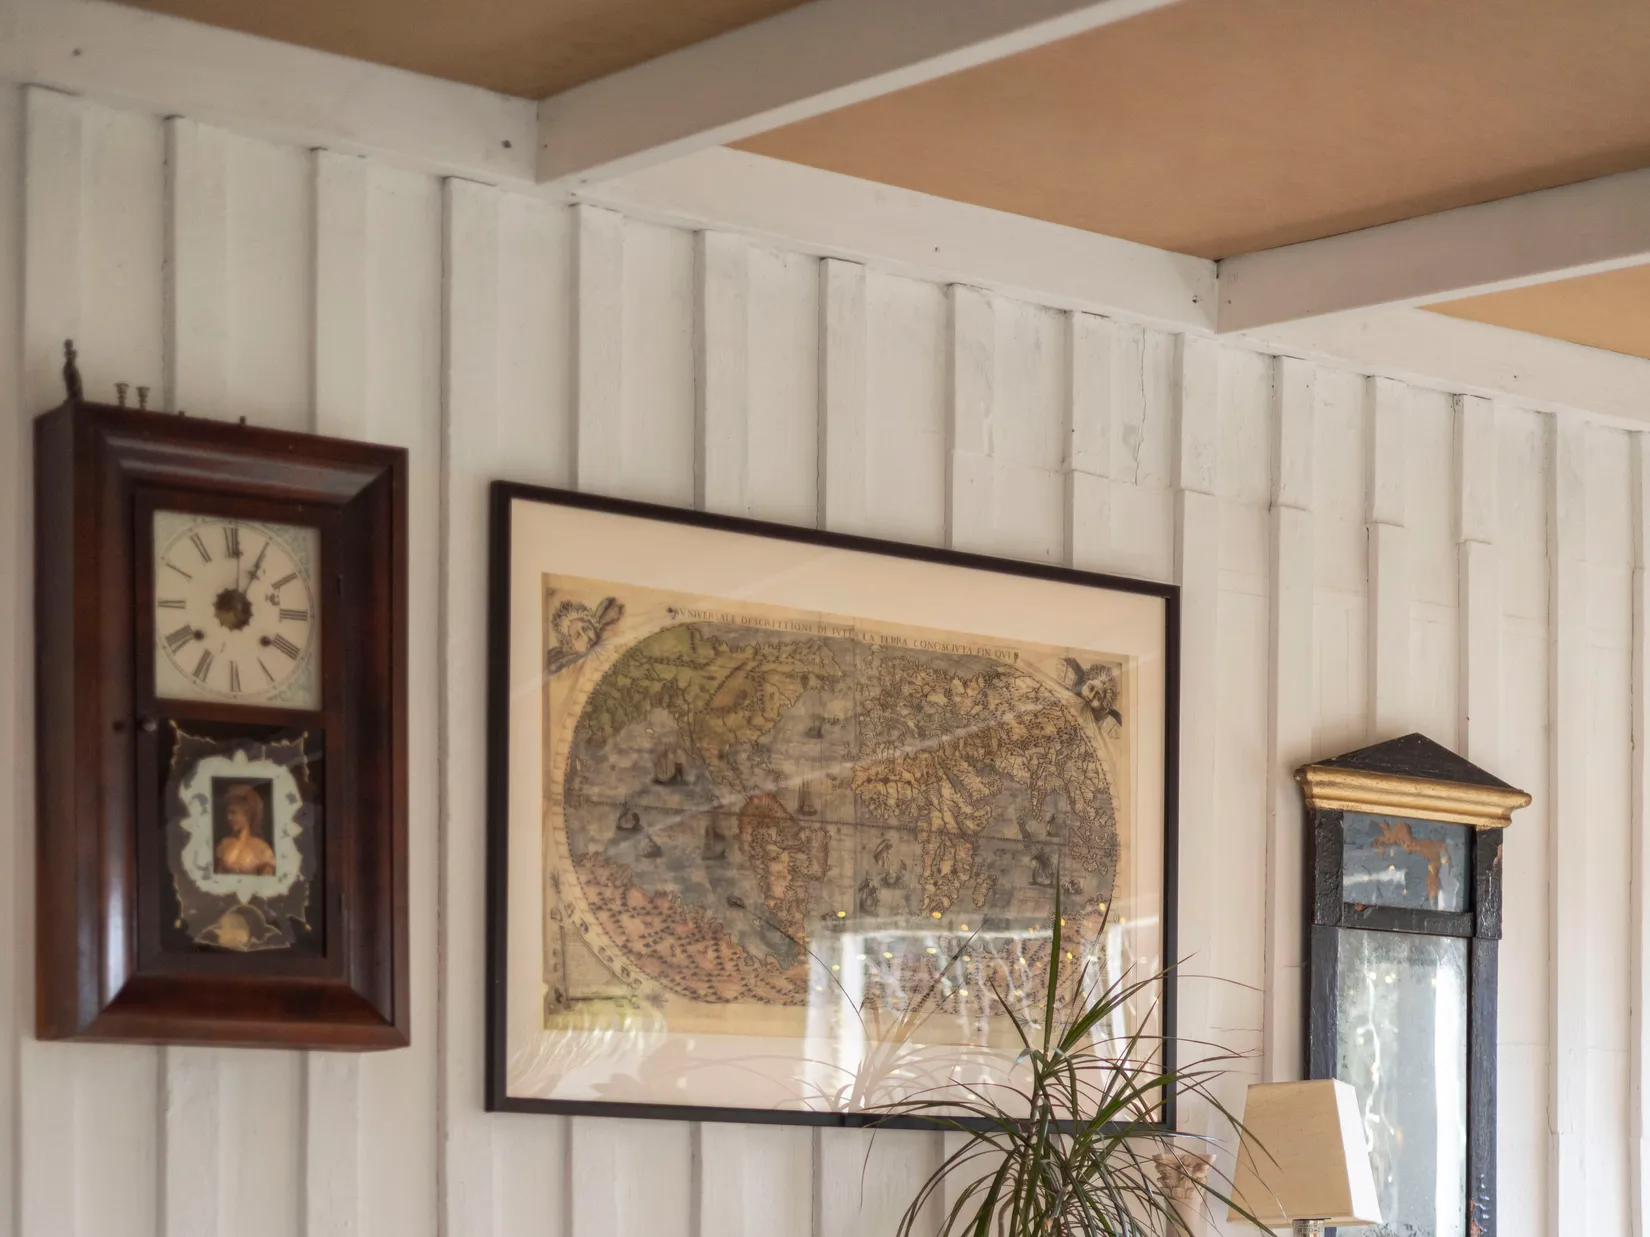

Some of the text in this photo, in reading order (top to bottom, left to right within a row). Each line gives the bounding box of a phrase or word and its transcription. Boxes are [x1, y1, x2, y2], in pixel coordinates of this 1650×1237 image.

[862, 634, 875, 642] LA
[880, 636, 908, 646] TERRA
[914, 640, 972, 655] CONOSCIVTA
[976, 647, 991, 658] FIN
